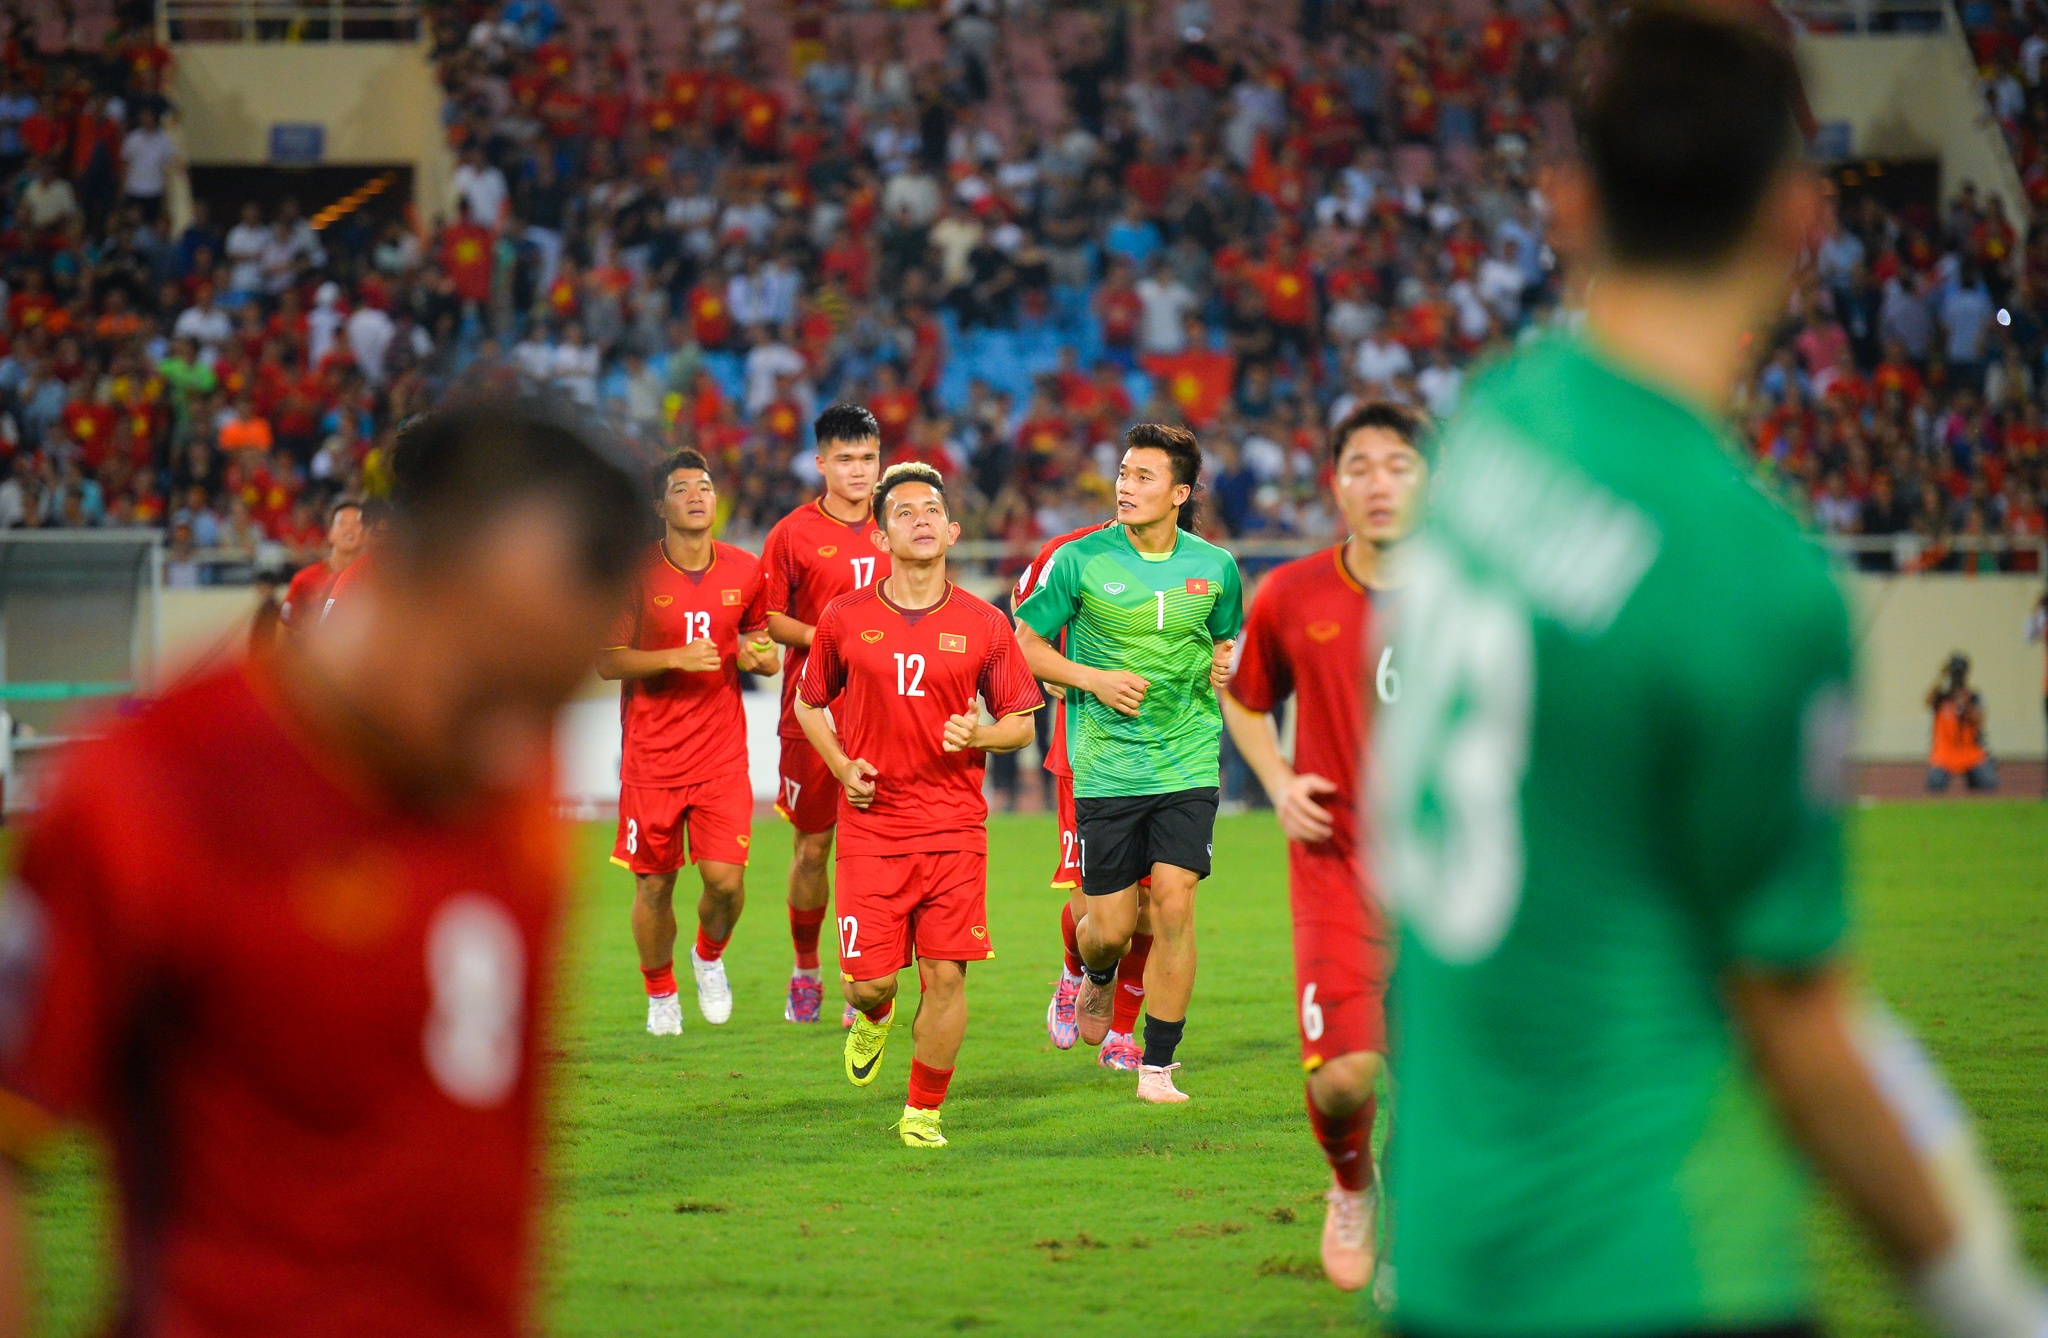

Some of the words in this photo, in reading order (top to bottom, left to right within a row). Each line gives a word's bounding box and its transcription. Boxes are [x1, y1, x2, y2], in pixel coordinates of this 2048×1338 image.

[850, 556, 876, 590] 17
[684, 610, 711, 645] 13
[1154, 590, 1165, 630] 1
[893, 652, 926, 697] 12
[1376, 646, 1401, 704] 6
[784, 775, 802, 811] 17
[1063, 830, 1080, 869] 2
[837, 915, 862, 959] 12
[1302, 982, 1325, 1041] 6
